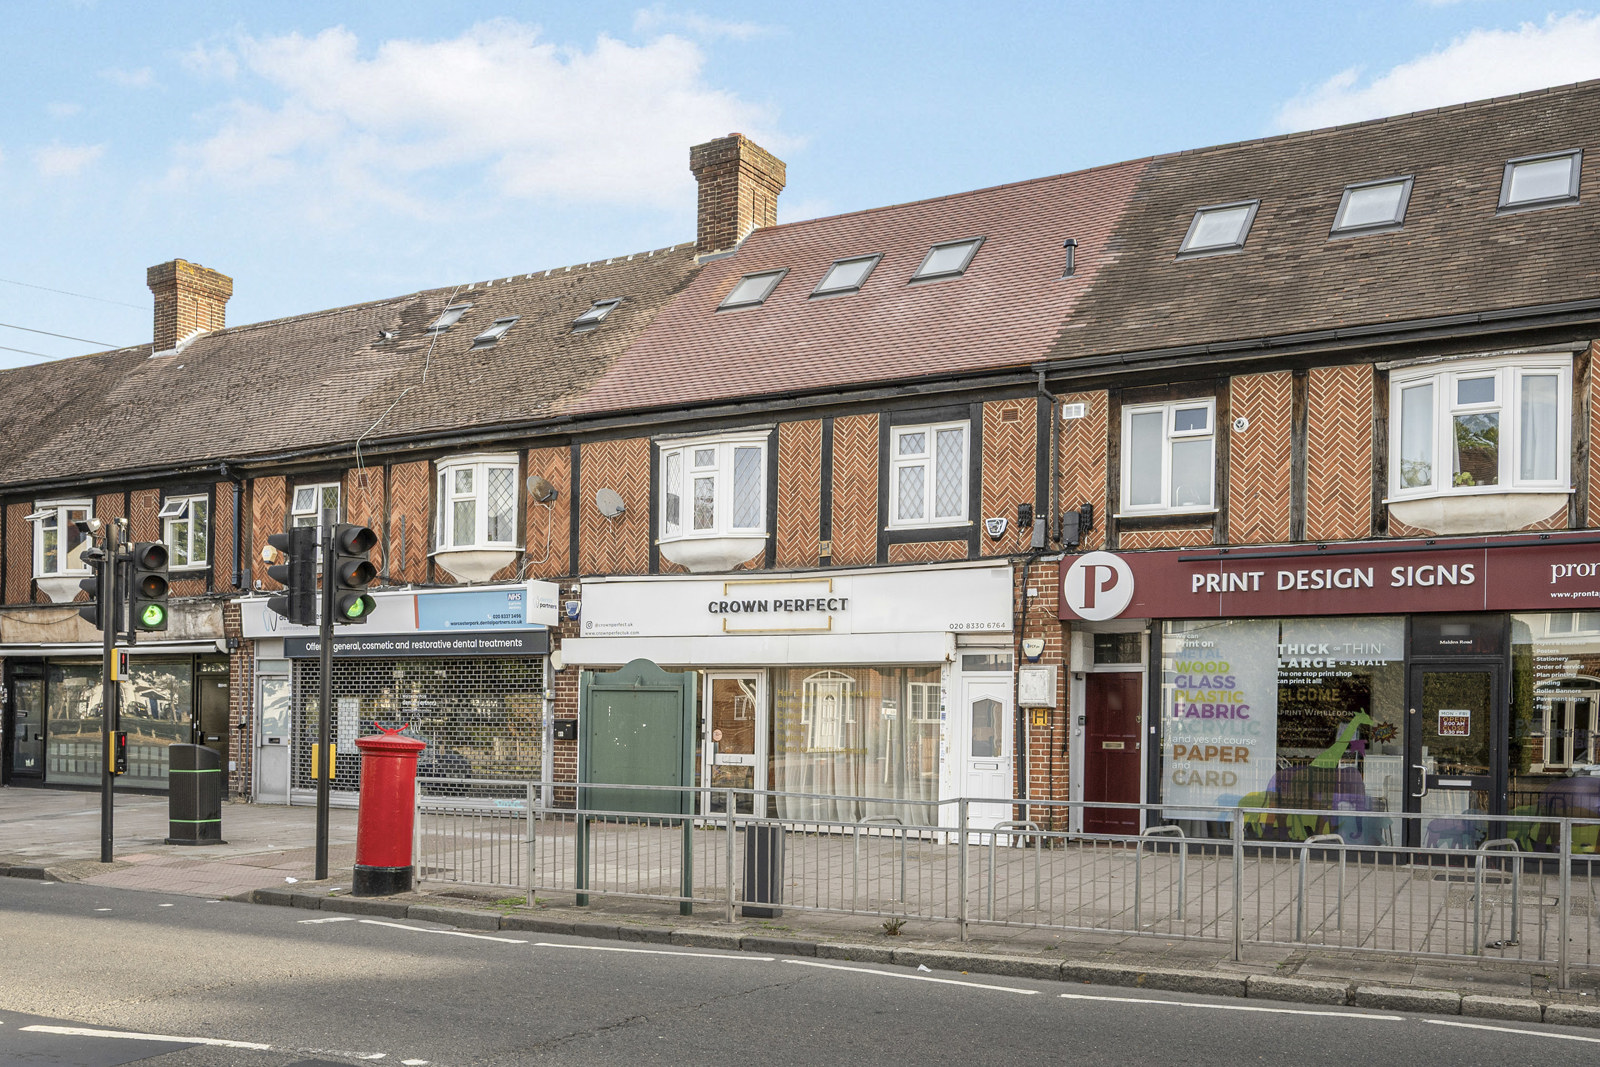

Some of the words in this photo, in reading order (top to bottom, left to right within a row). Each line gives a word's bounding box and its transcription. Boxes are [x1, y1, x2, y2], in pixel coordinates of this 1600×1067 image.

[1192, 571, 1264, 593] PRINT
[1277, 567, 1374, 591] DESIGN
[1390, 563, 1476, 588] SIGNS
[1079, 565, 1119, 609] P
[1550, 591, 1600, 599] www.pronta
[708, 600, 768, 614] CROWN
[773, 598, 848, 613] PERFECT
[333, 641, 361, 652] general,
[362, 641, 394, 649] cosmetic
[395, 640, 410, 649] and
[412, 640, 452, 649] restorative
[452, 639, 478, 648] dental
[479, 638, 523, 648] treatments
[1175, 639, 1200, 648] Print
[1201, 640, 1214, 648] on
[1277, 643, 1329, 655] THICK
[1342, 643, 1382, 654] THIN
[1175, 648, 1223, 659] METAL
[1175, 661, 1230, 673] WOOD
[1277, 658, 1336, 668] LARGE
[1174, 675, 1236, 689] GLASS
[1174, 690, 1244, 703] PLASTIC
[1279, 688, 1341, 701] ELCOME
[1034, 709, 1046, 726] H
[1174, 703, 1250, 719] FABRIC
[1173, 720, 1261, 735] ACRYLIC
[1211, 736, 1222, 744] of
[1223, 737, 1257, 745] course
[777, 744, 797, 753] Nano
[1173, 744, 1249, 763] PAPER
[1172, 761, 1191, 769] and
[1172, 770, 1238, 787] CARD
